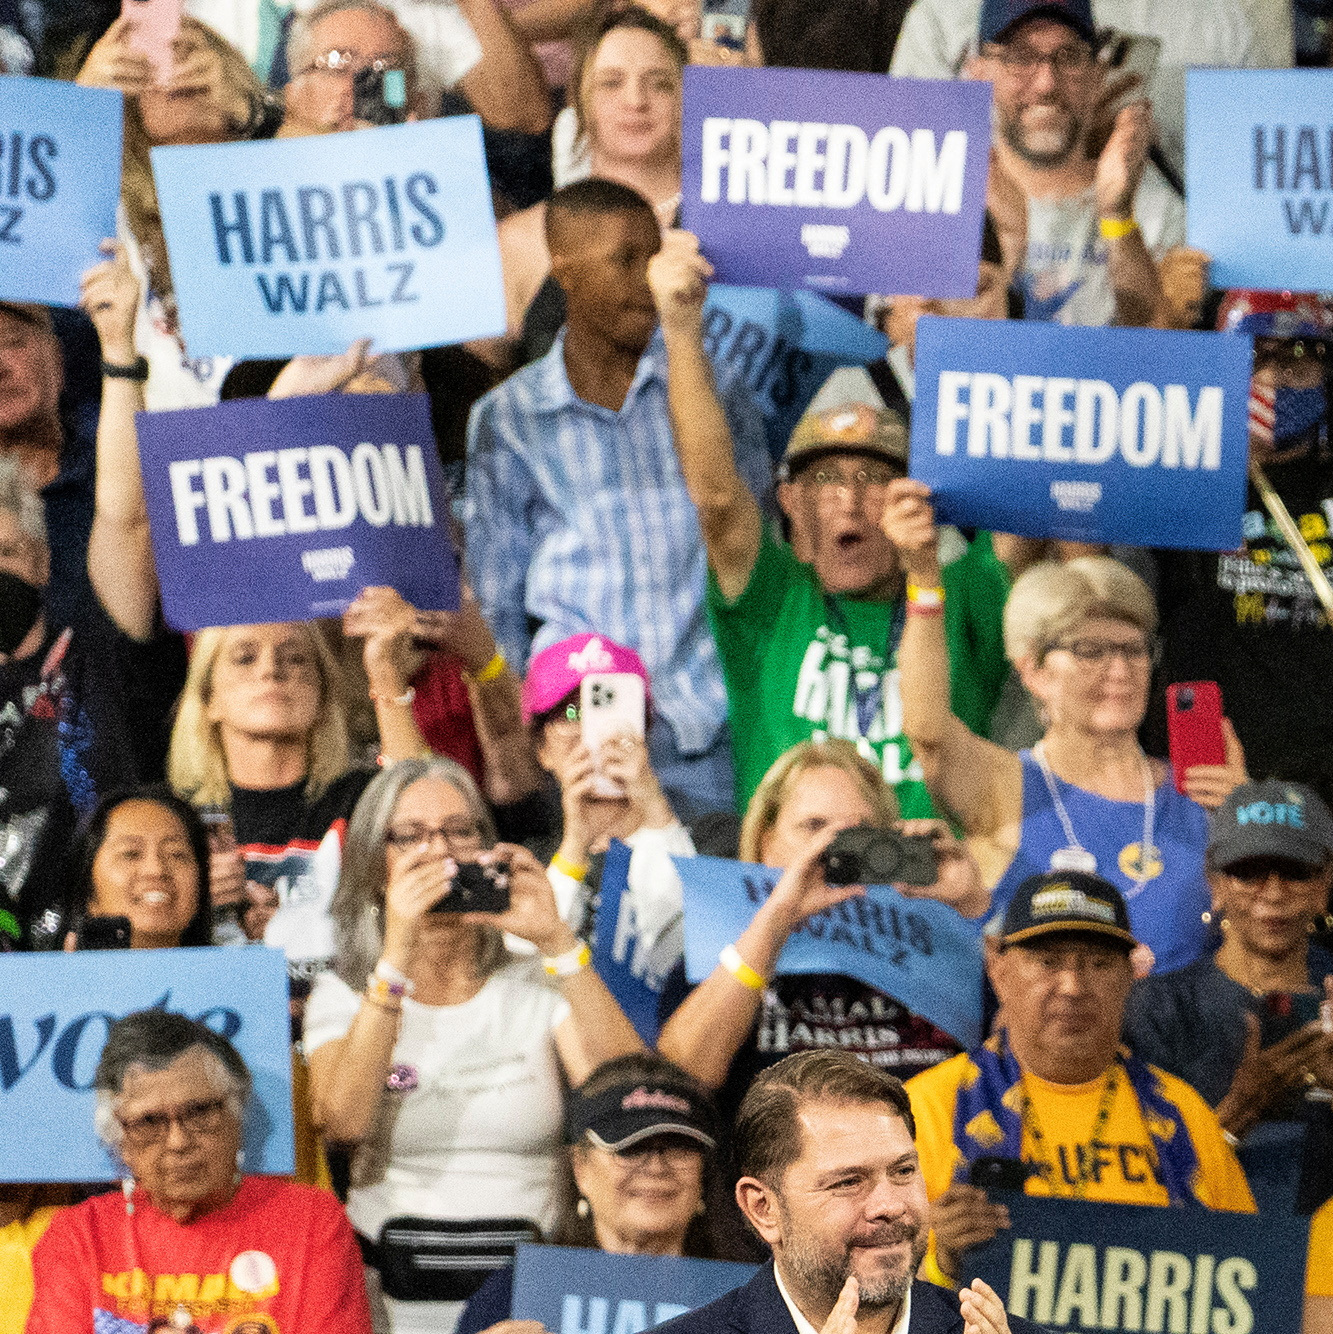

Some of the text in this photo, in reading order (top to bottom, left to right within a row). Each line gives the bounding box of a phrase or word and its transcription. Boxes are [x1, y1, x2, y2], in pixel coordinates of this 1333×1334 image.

[702, 117, 967, 216] FREEDOM
[209, 171, 445, 265] HARRIS
[256, 262, 420, 316] WALZ
[936, 370, 1223, 470] FREEDOM
[169, 443, 433, 546] FREEDOM
[2, 990, 242, 1092] vo
